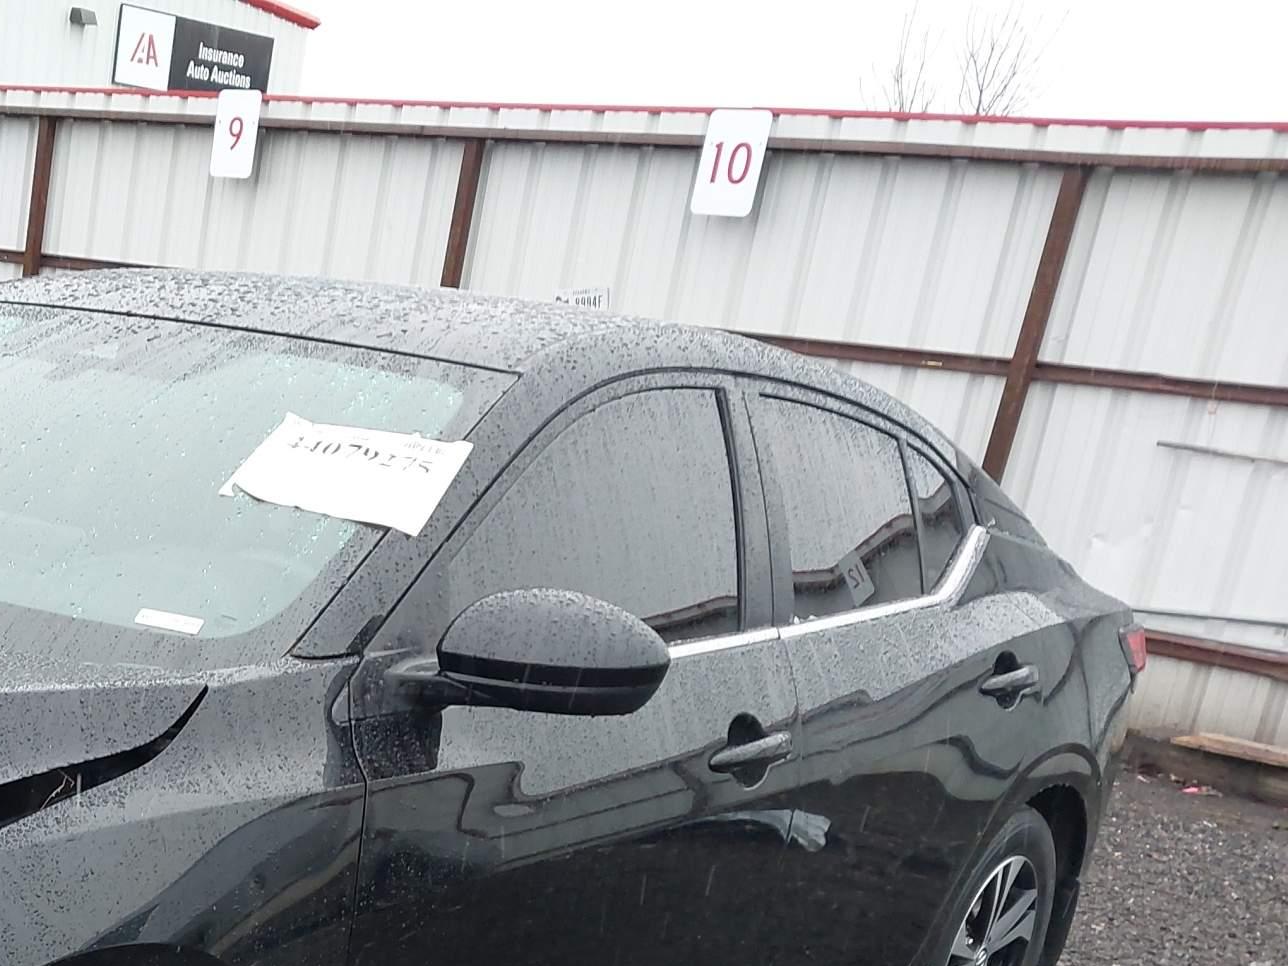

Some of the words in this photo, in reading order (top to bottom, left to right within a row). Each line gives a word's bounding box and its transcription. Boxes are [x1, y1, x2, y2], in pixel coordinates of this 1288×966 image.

[198, 41, 244, 68] Insurance
[186, 59, 210, 82] Auto
[210, 65, 251, 89] Auctions
[228, 116, 244, 151] 9
[710, 141, 753, 185] 10
